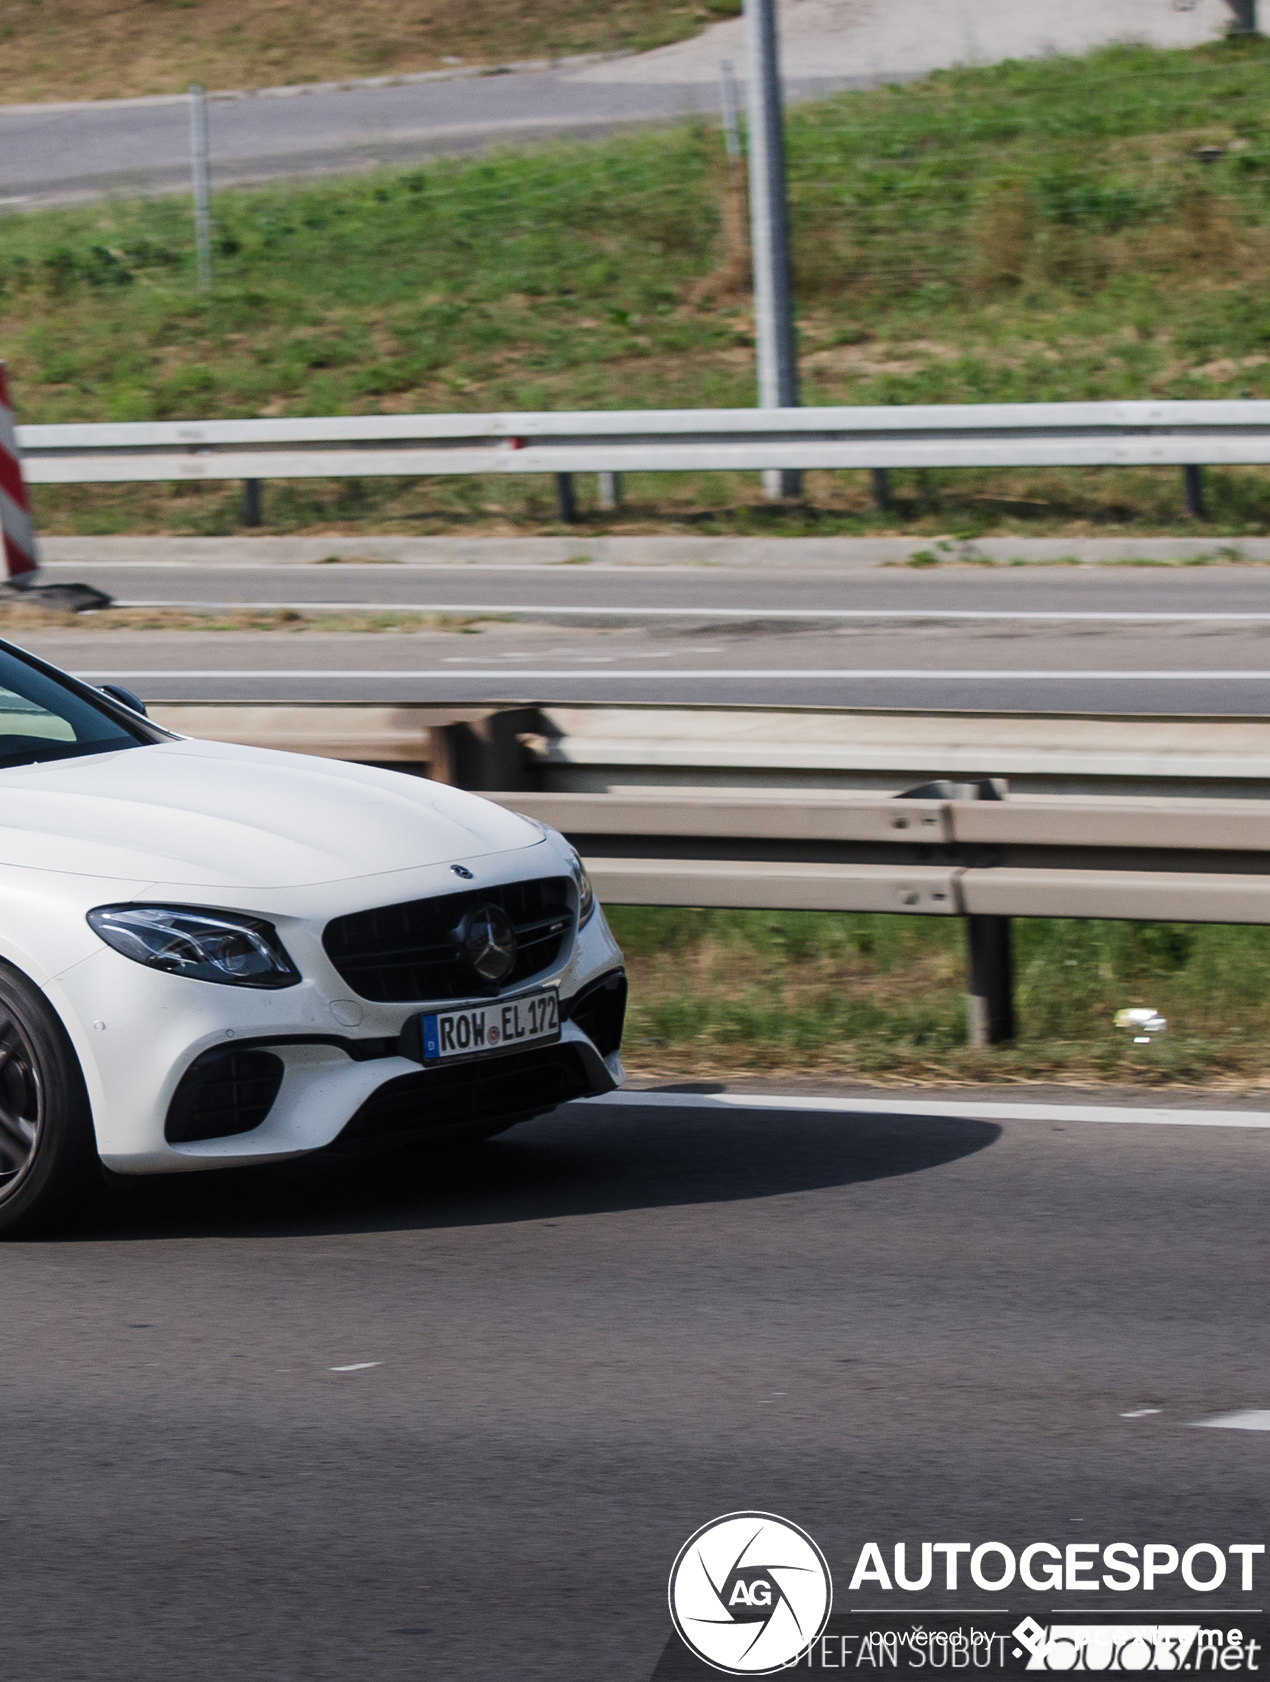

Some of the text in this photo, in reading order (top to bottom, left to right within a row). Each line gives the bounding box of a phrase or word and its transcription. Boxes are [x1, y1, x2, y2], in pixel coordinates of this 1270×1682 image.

[440, 996, 557, 1051] ROW EL 172
